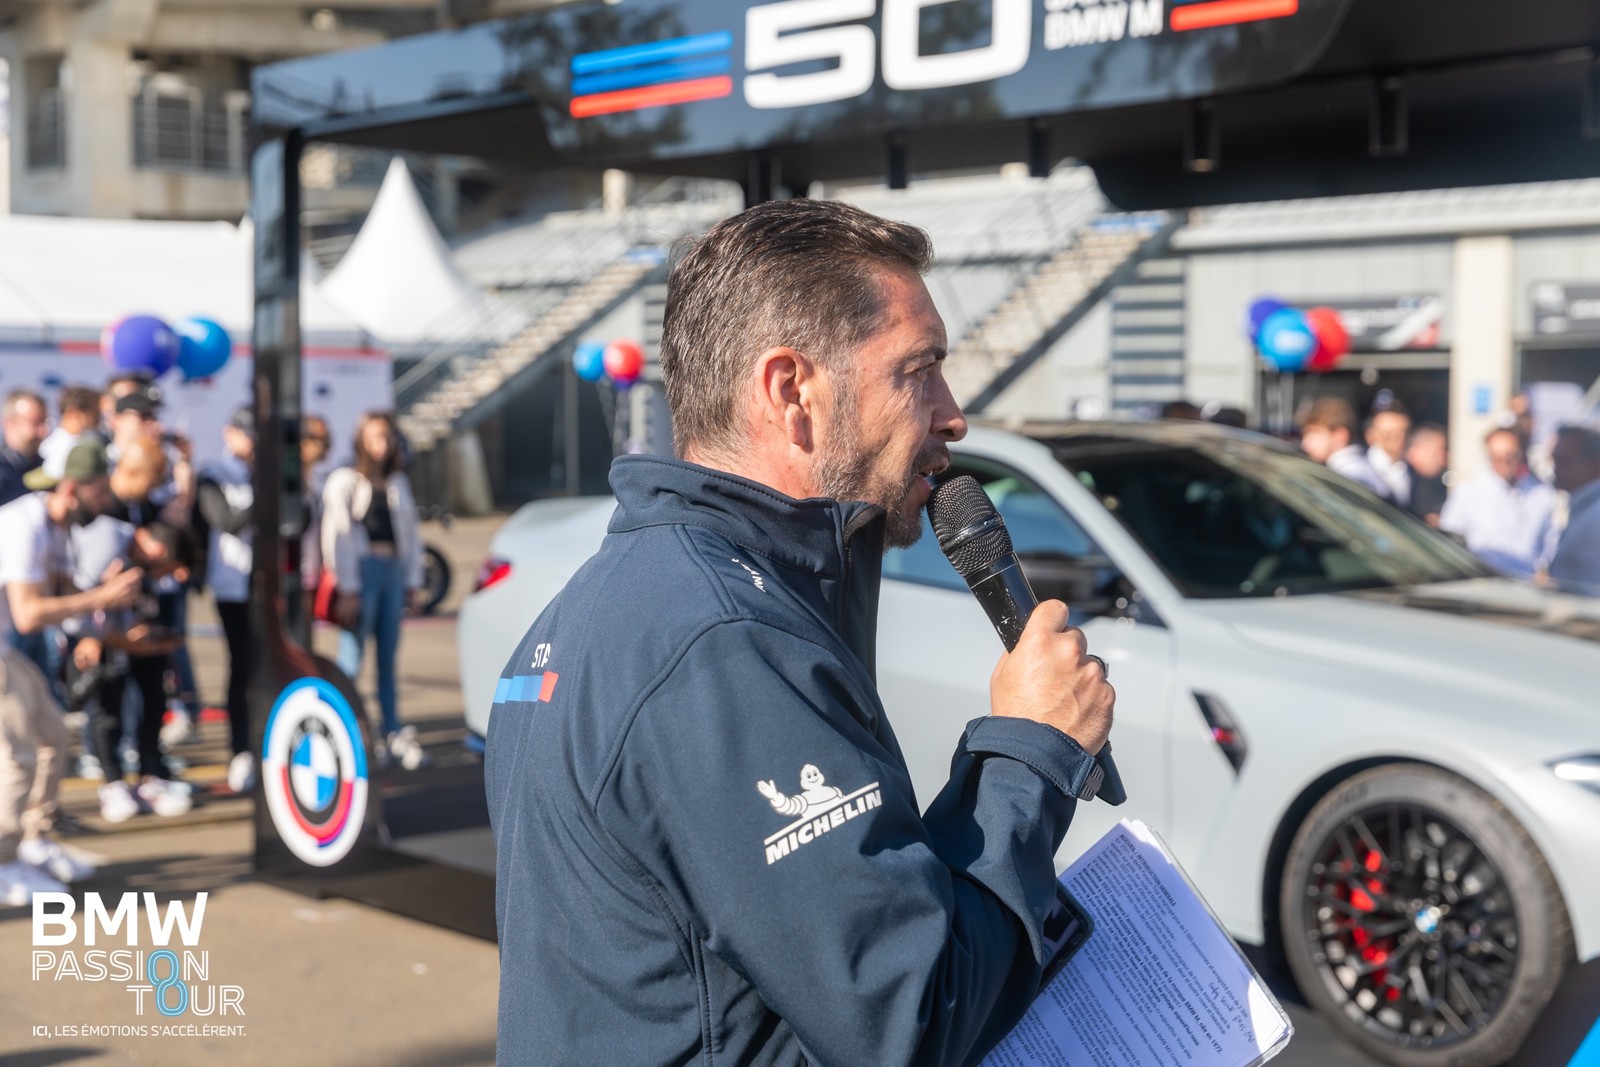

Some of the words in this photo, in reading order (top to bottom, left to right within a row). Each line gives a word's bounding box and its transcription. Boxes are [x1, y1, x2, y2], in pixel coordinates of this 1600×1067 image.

[743, 0, 1032, 109] 50
[1043, 3, 1127, 50] BMW
[1129, 0, 1165, 38] M
[765, 790, 883, 866] MICHELIN
[1100, 880, 1112, 895] 2022
[1150, 953, 1159, 962] 50
[1183, 1000, 1197, 1016] BMW
[1192, 1014, 1202, 1023] M,
[1197, 1021, 1209, 1033] née
[1204, 1031, 1212, 1040] en
[1209, 1038, 1224, 1055] 1972.
